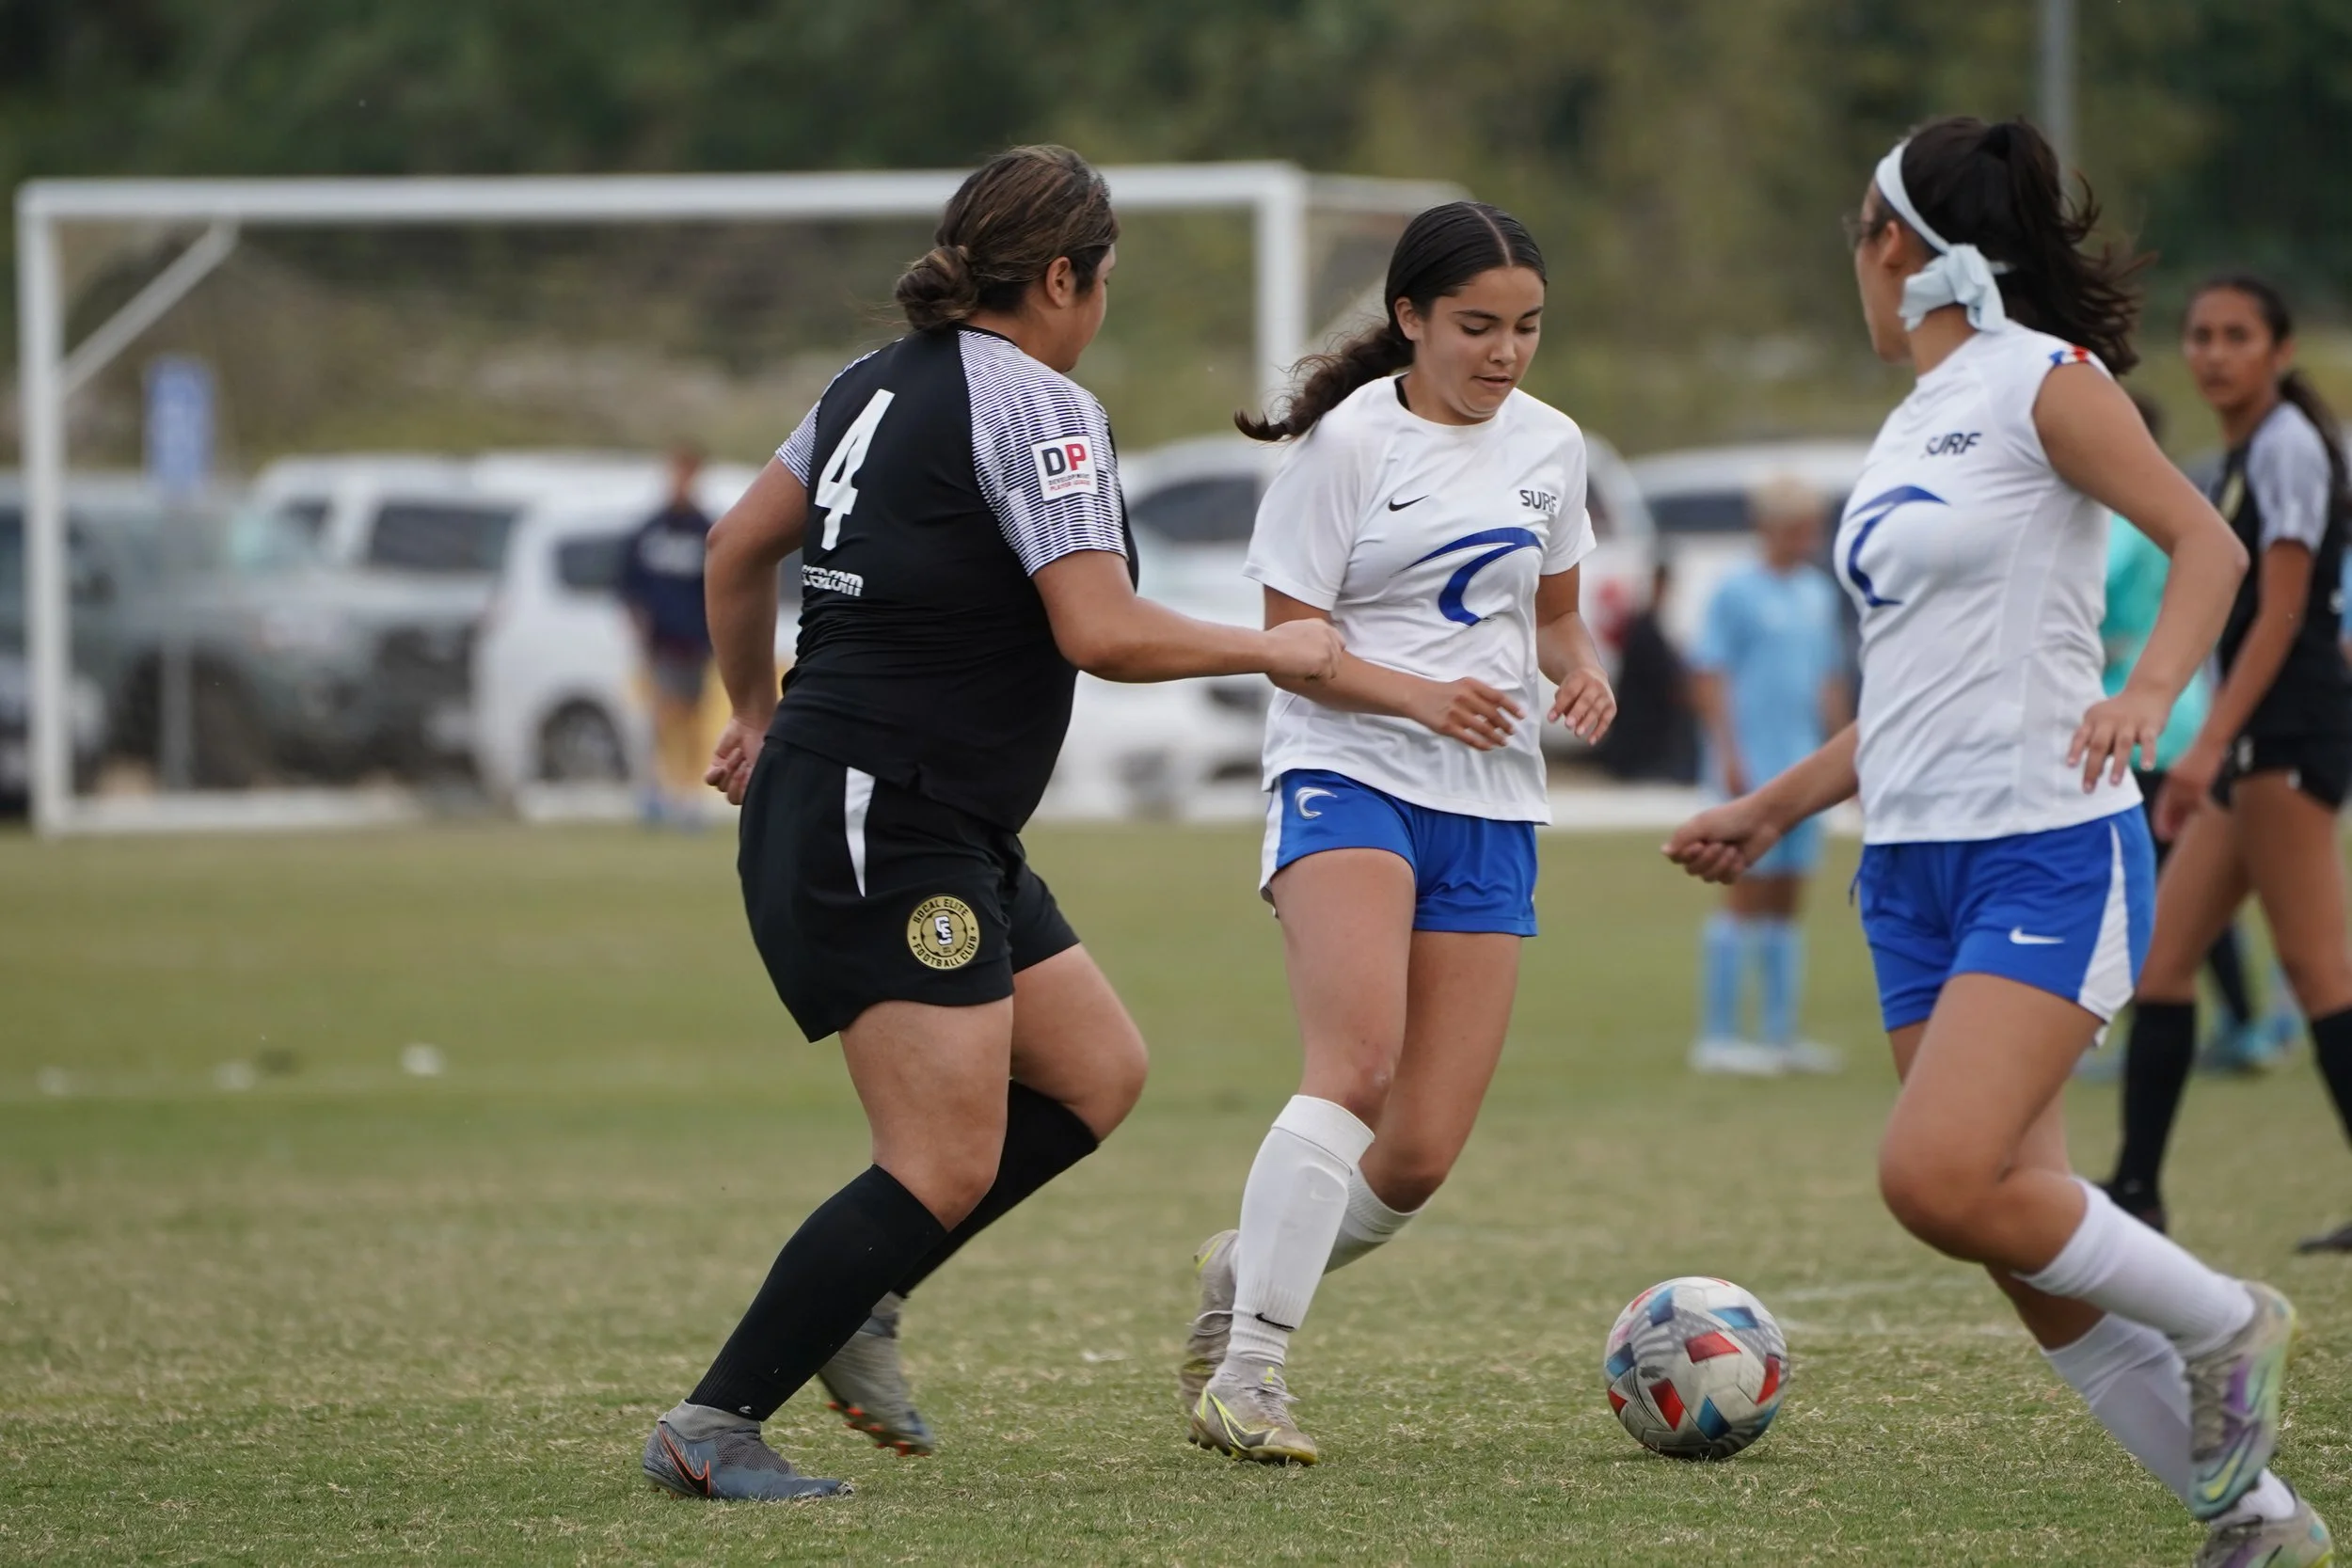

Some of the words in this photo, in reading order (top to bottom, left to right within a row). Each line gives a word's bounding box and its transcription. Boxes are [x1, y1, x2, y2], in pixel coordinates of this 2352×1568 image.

[815, 388, 895, 550] 4
[1041, 443, 1087, 477] DP
[1519, 489, 1557, 514] SURF
[944, 898, 969, 917] ELITE
[913, 943, 961, 968] FOOTBALL
[960, 935, 977, 960] CLUB
